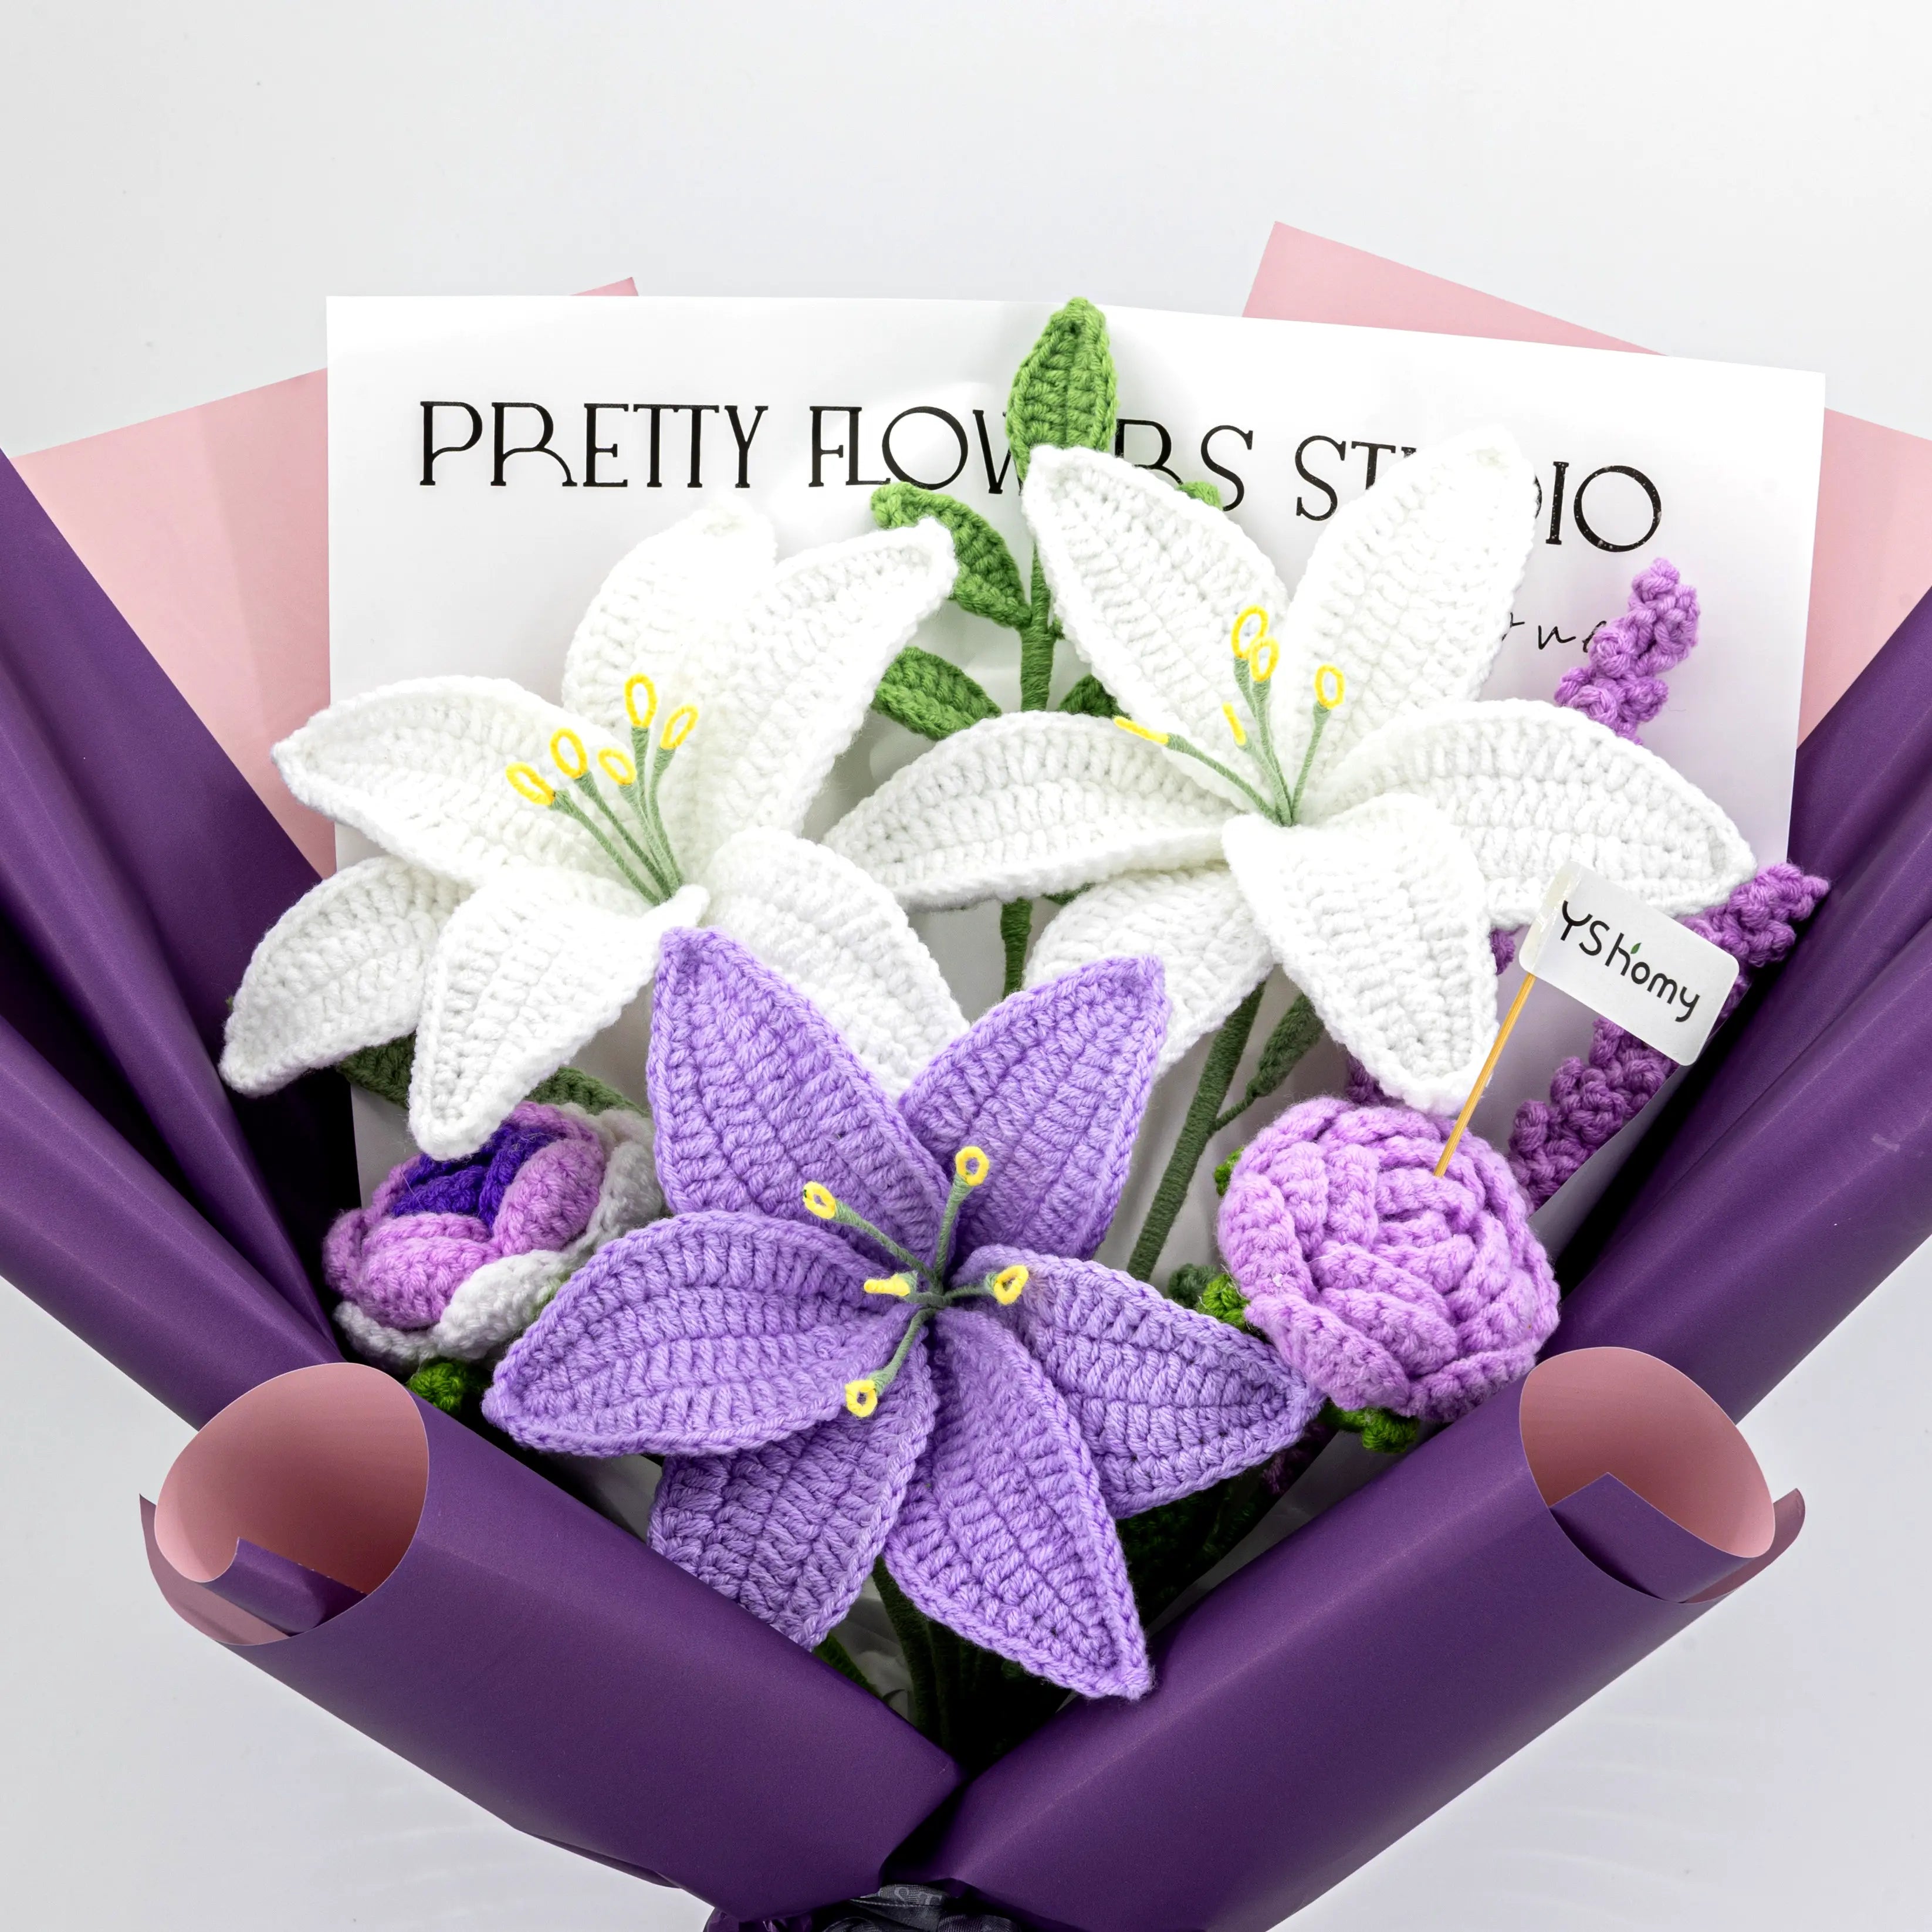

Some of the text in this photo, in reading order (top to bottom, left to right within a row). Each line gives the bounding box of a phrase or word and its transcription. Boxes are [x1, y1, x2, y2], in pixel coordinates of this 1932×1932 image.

[419, 400, 1662, 553] PRETTY FLOWRS STIO
[1559, 899, 1701, 1023] YShomy
